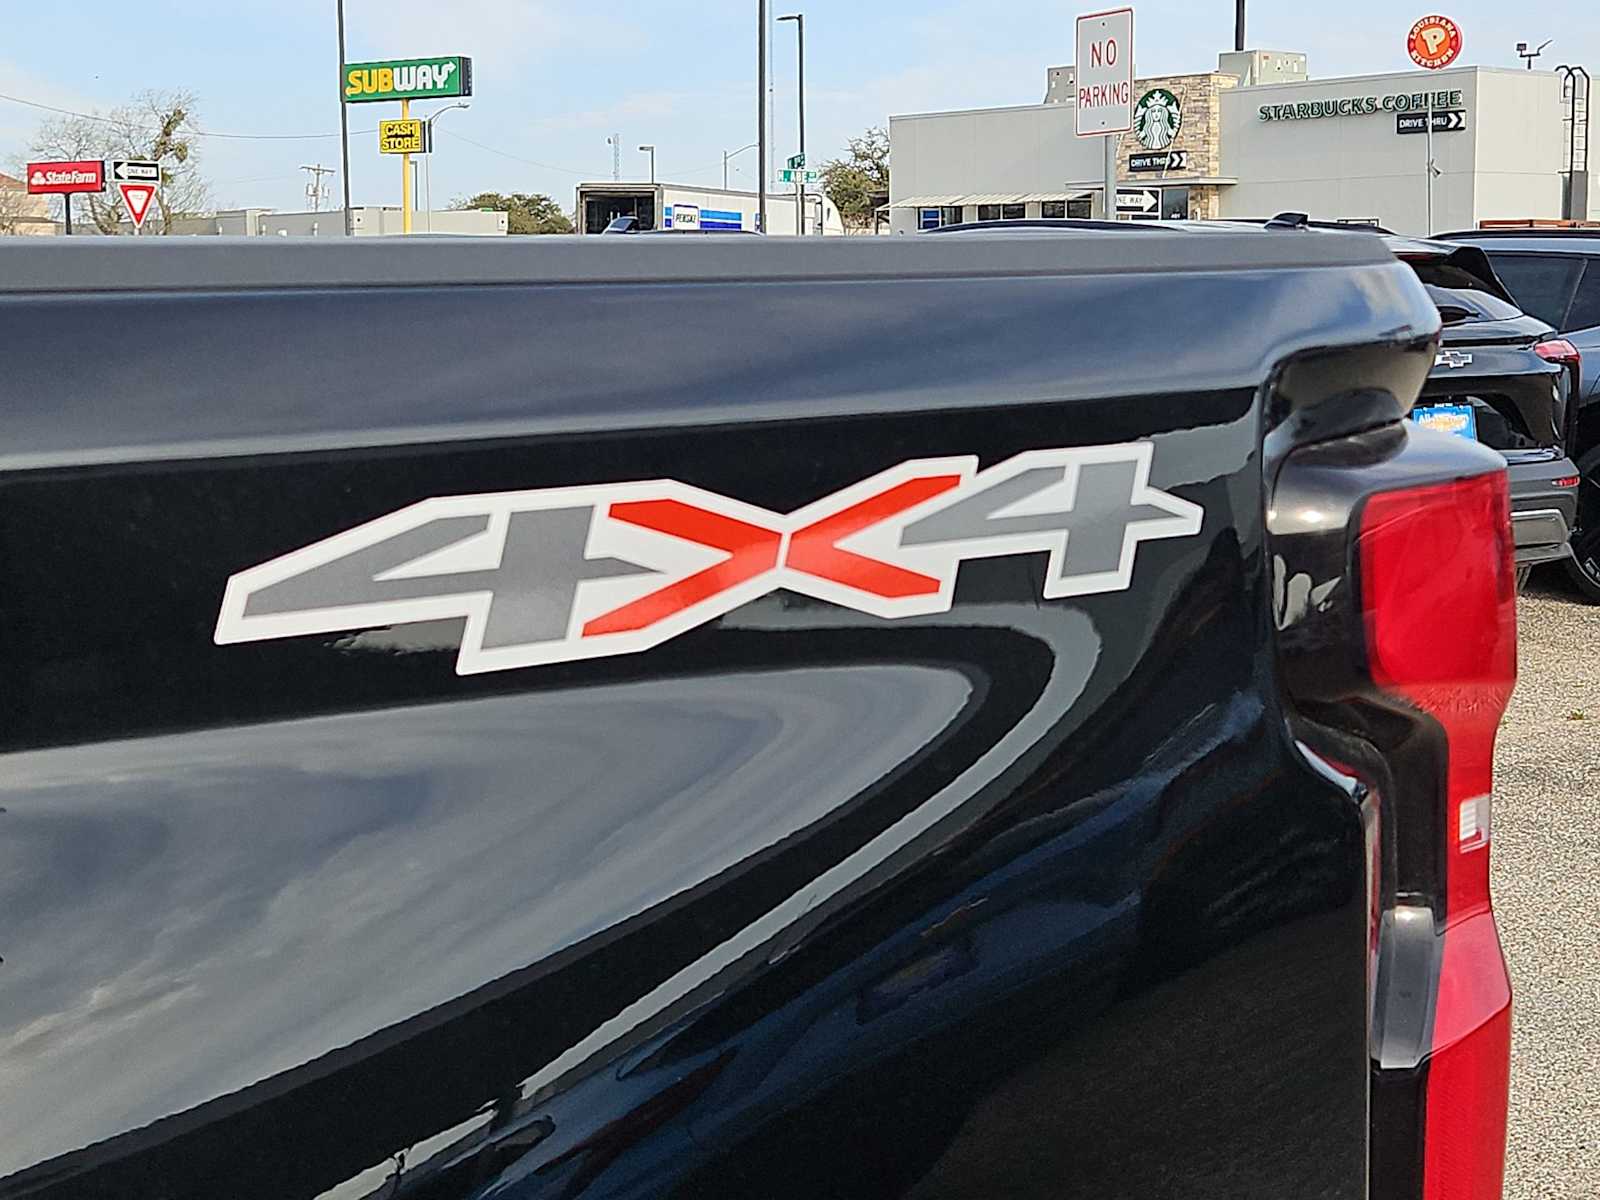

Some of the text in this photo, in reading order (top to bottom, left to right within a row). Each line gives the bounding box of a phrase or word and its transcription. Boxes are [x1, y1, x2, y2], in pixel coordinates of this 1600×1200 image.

[1410, 17, 1456, 39] LOUISIANA
[1421, 28, 1445, 54] P
[1091, 39, 1117, 68] NO
[1411, 48, 1454, 67] KITCHEN
[345, 61, 457, 97] SUBWAY
[1079, 82, 1129, 109] PARKING
[1259, 97, 1377, 121] STARBUCKS
[385, 123, 415, 136] CASH
[1399, 119, 1424, 128] DRIVE
[382, 137, 420, 150] STORE
